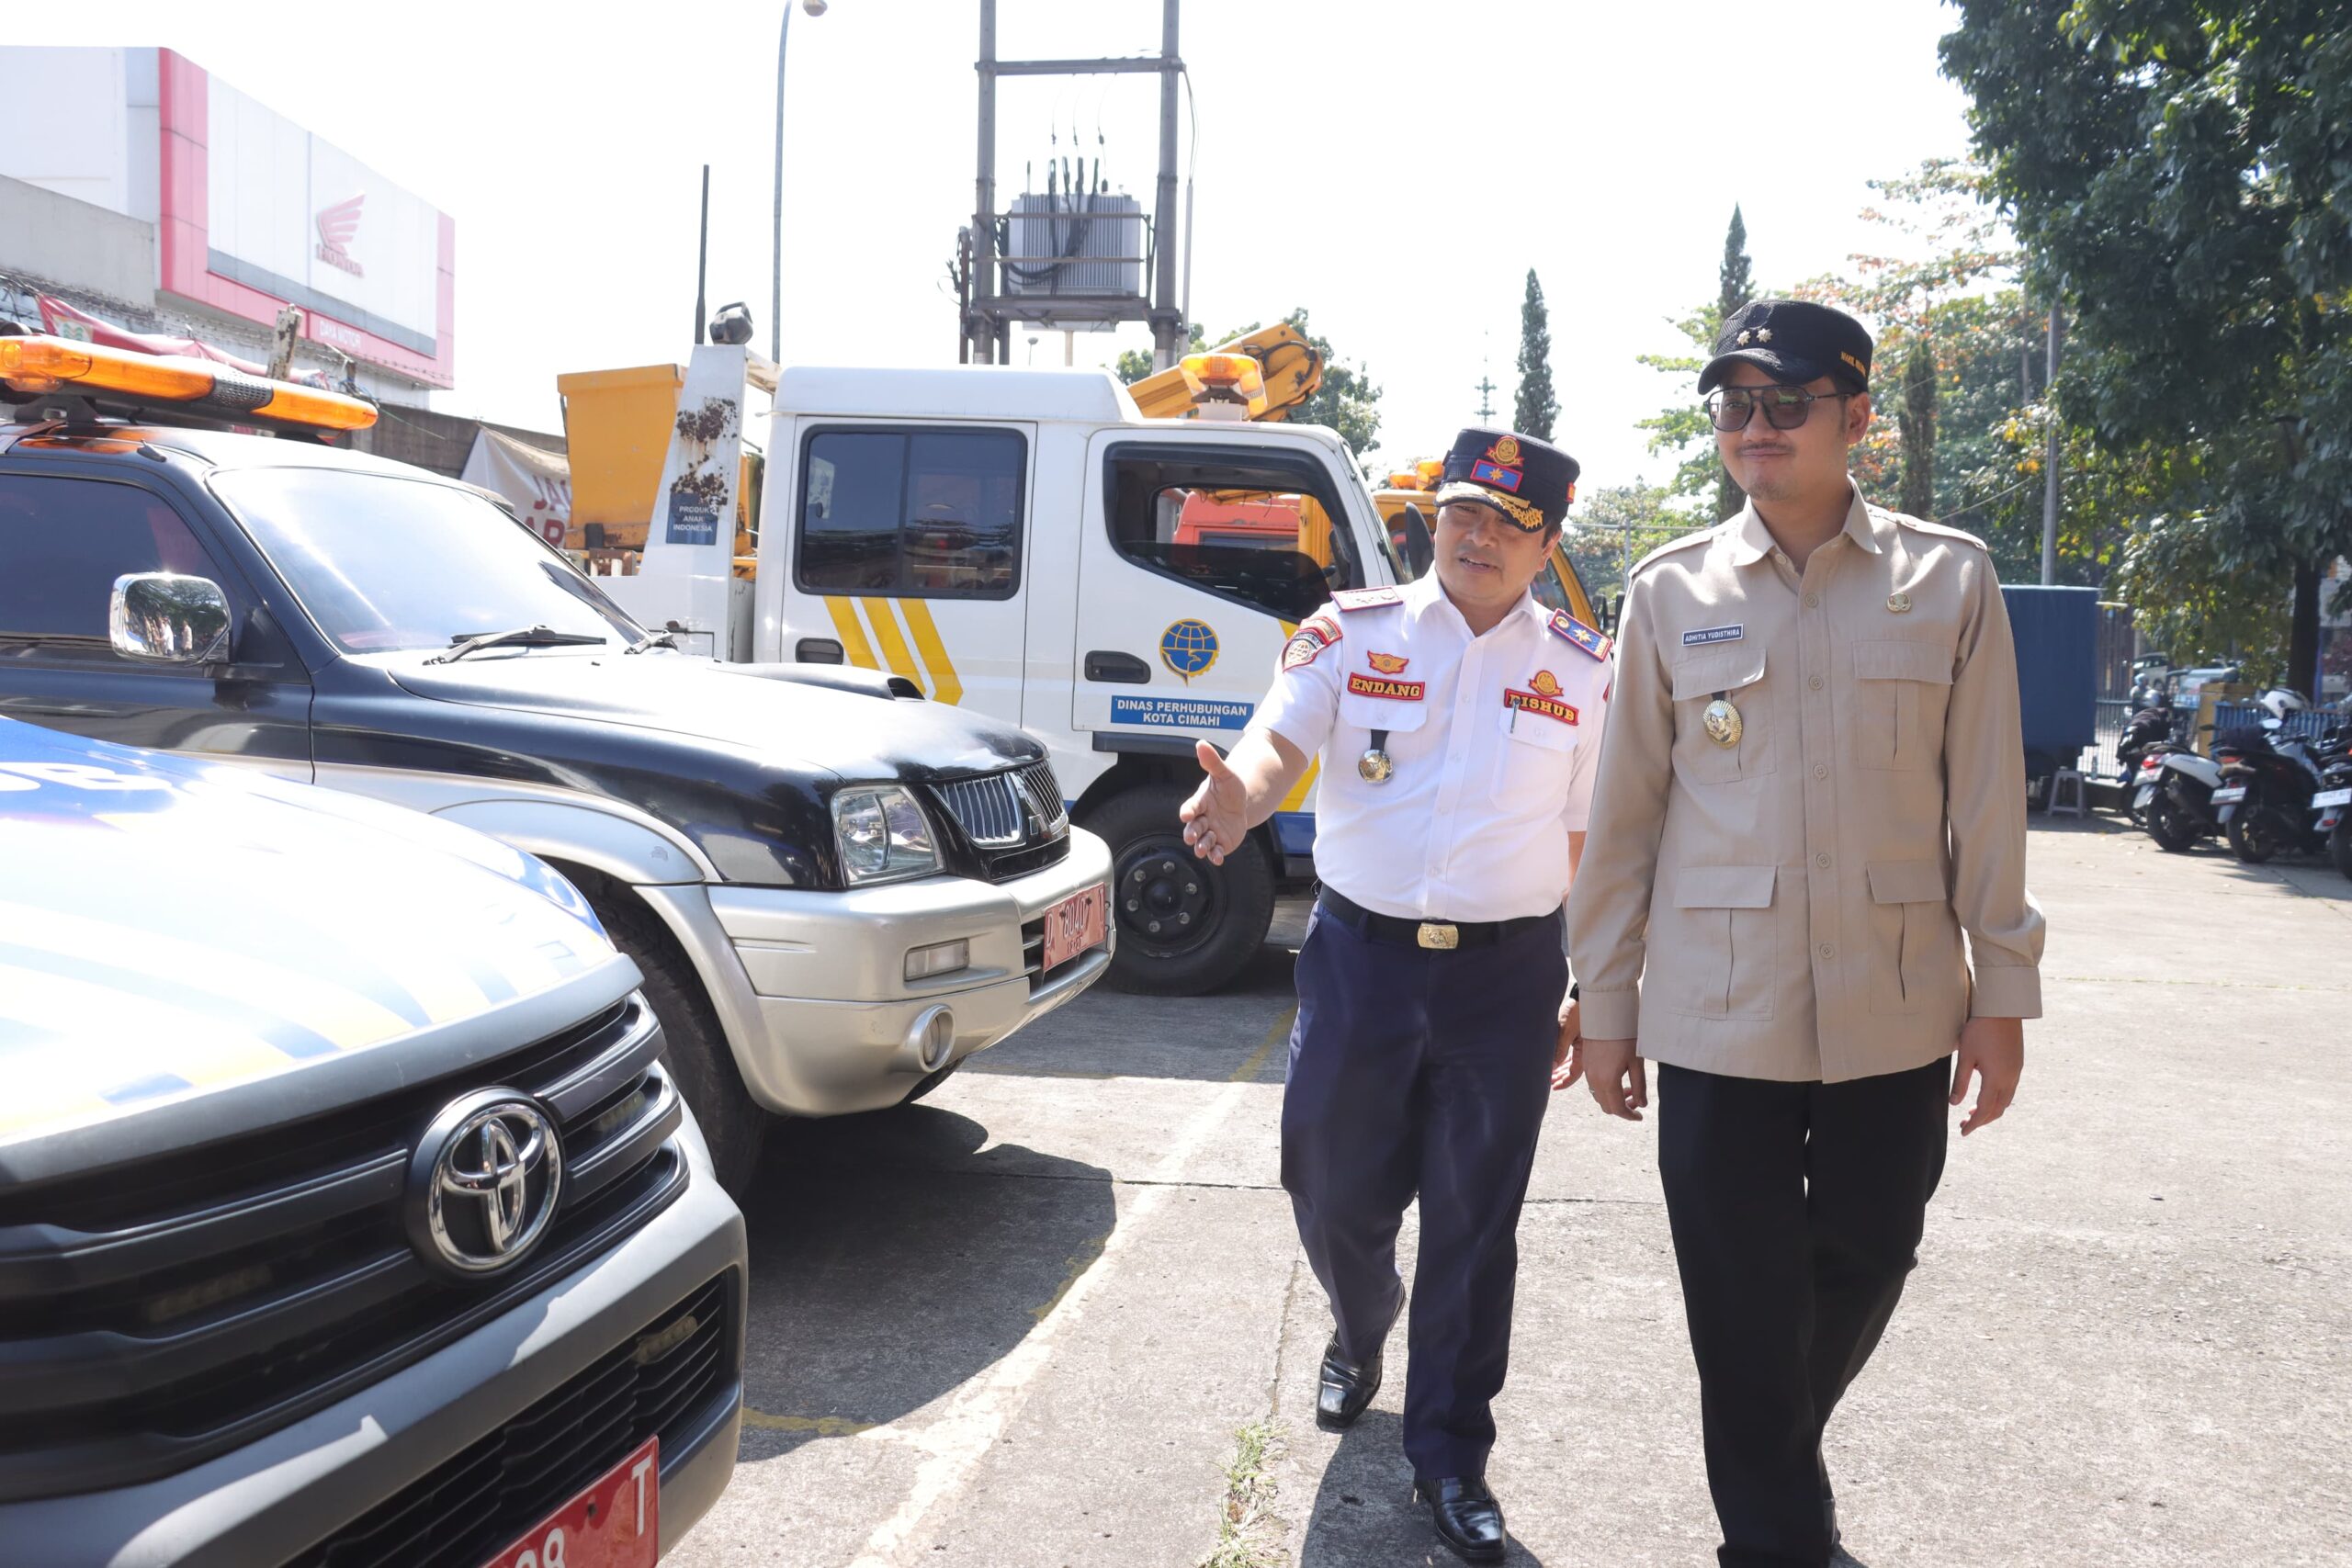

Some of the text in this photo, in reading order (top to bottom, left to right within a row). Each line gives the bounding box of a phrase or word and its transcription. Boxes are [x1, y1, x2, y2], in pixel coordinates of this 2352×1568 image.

[679, 505, 709, 514] PRODUK
[683, 514, 705, 523] ANAK
[673, 524, 713, 532] INDONESIA
[1707, 628, 1740, 639] YUDISTHIRA
[1351, 677, 1420, 697] ENDANG
[1117, 699, 1248, 716] DINAS PERHUBUNGAN
[1143, 712, 1220, 727] KOTA CIMAHI
[631, 1454, 652, 1537] T
